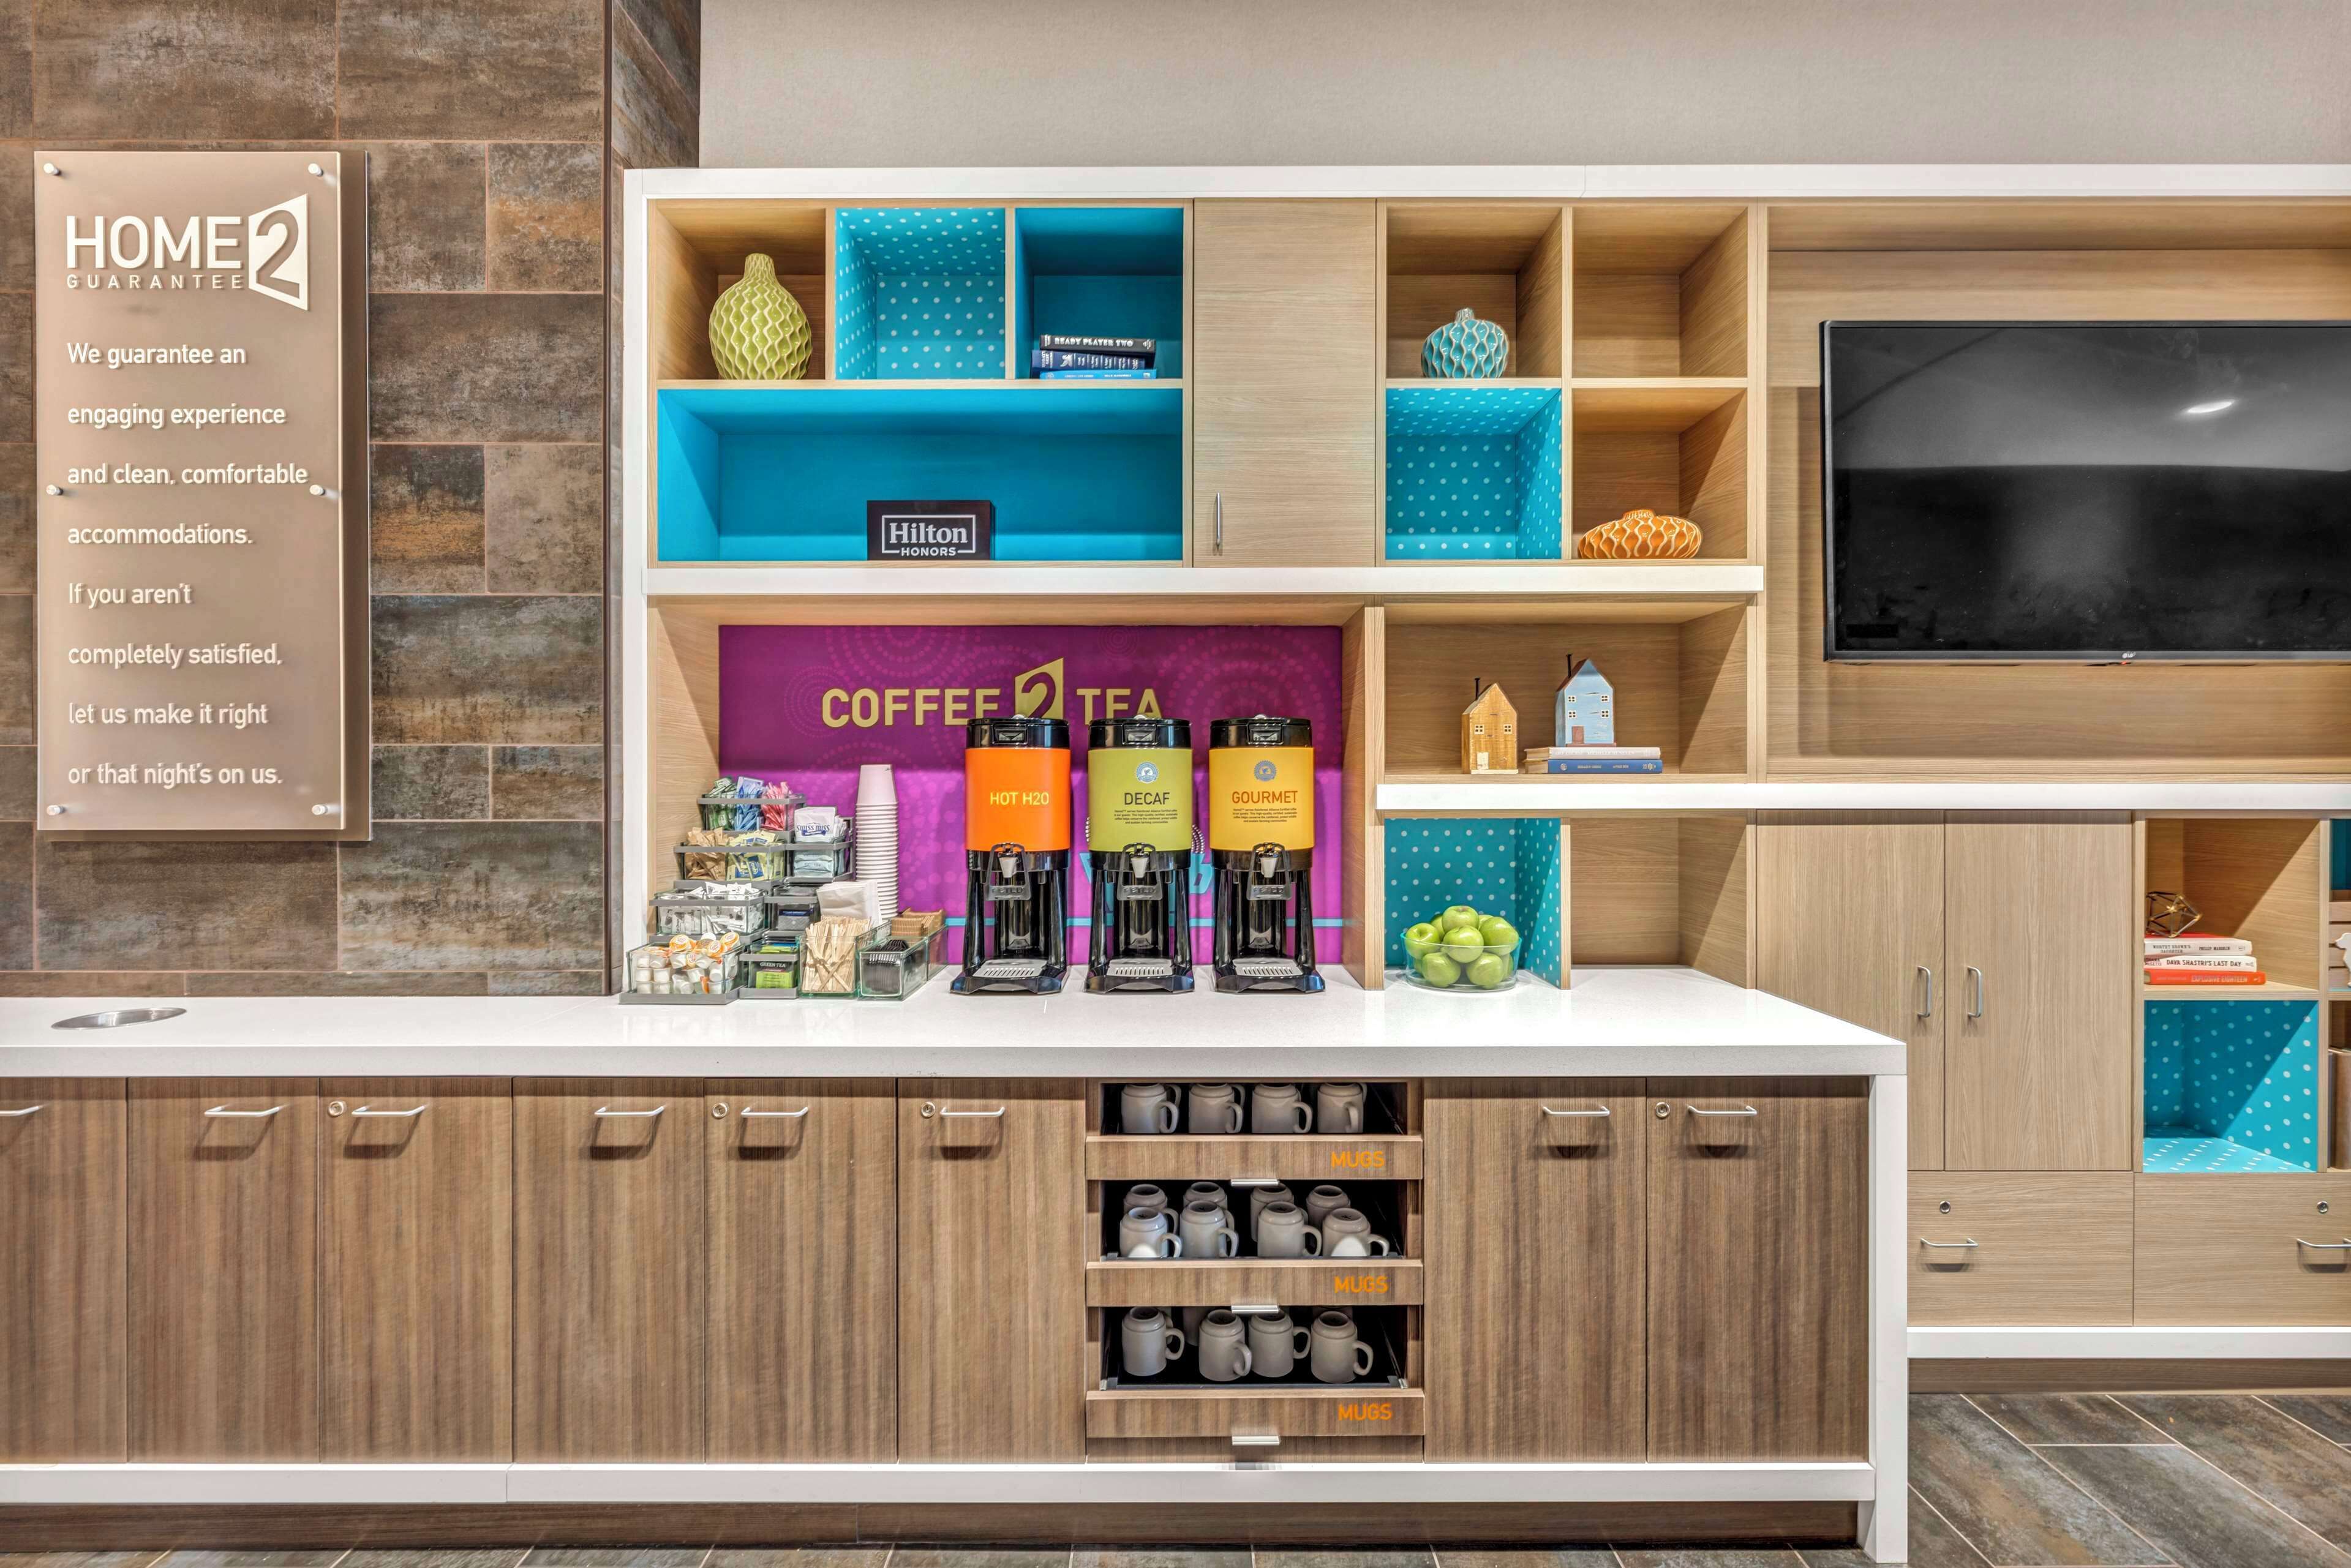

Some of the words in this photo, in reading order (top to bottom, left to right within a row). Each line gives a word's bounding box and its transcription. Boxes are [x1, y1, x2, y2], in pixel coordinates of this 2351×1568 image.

[67, 215, 243, 270] HOME
[67, 274, 244, 290] GUARANTEE
[67, 342, 102, 364] We
[107, 344, 214, 369] guarantee
[220, 347, 246, 364] an
[67, 402, 165, 430] engaging
[170, 402, 287, 430] experience
[67, 462, 108, 484] and
[113, 462, 176, 486] clean,
[181, 462, 309, 484] comfortable
[67, 523, 254, 545] accommodations.
[889, 522, 968, 544] Hilton
[901, 547, 957, 557] HONORS
[69, 582, 84, 604] If
[86, 587, 127, 609] you
[131, 582, 193, 604] aren't
[67, 642, 184, 670] completely
[188, 642, 284, 666] satisfied,
[68, 702, 94, 724] let
[100, 707, 127, 724] us
[134, 702, 194, 724] make
[199, 702, 213, 724] it
[218, 702, 269, 730] right
[68, 767, 91, 784] or
[97, 762, 139, 784] that
[143, 762, 213, 790] night's
[218, 767, 246, 784] on
[251, 767, 284, 784] us.
[990, 792, 1018, 805] HOT
[1124, 792, 1170, 805] DECAF
[1232, 790, 1298, 804] GOURMET
[1331, 1151, 1385, 1169] MUGS
[1334, 1276, 1388, 1293] MUGS
[1338, 1403, 1392, 1421] MUGS
